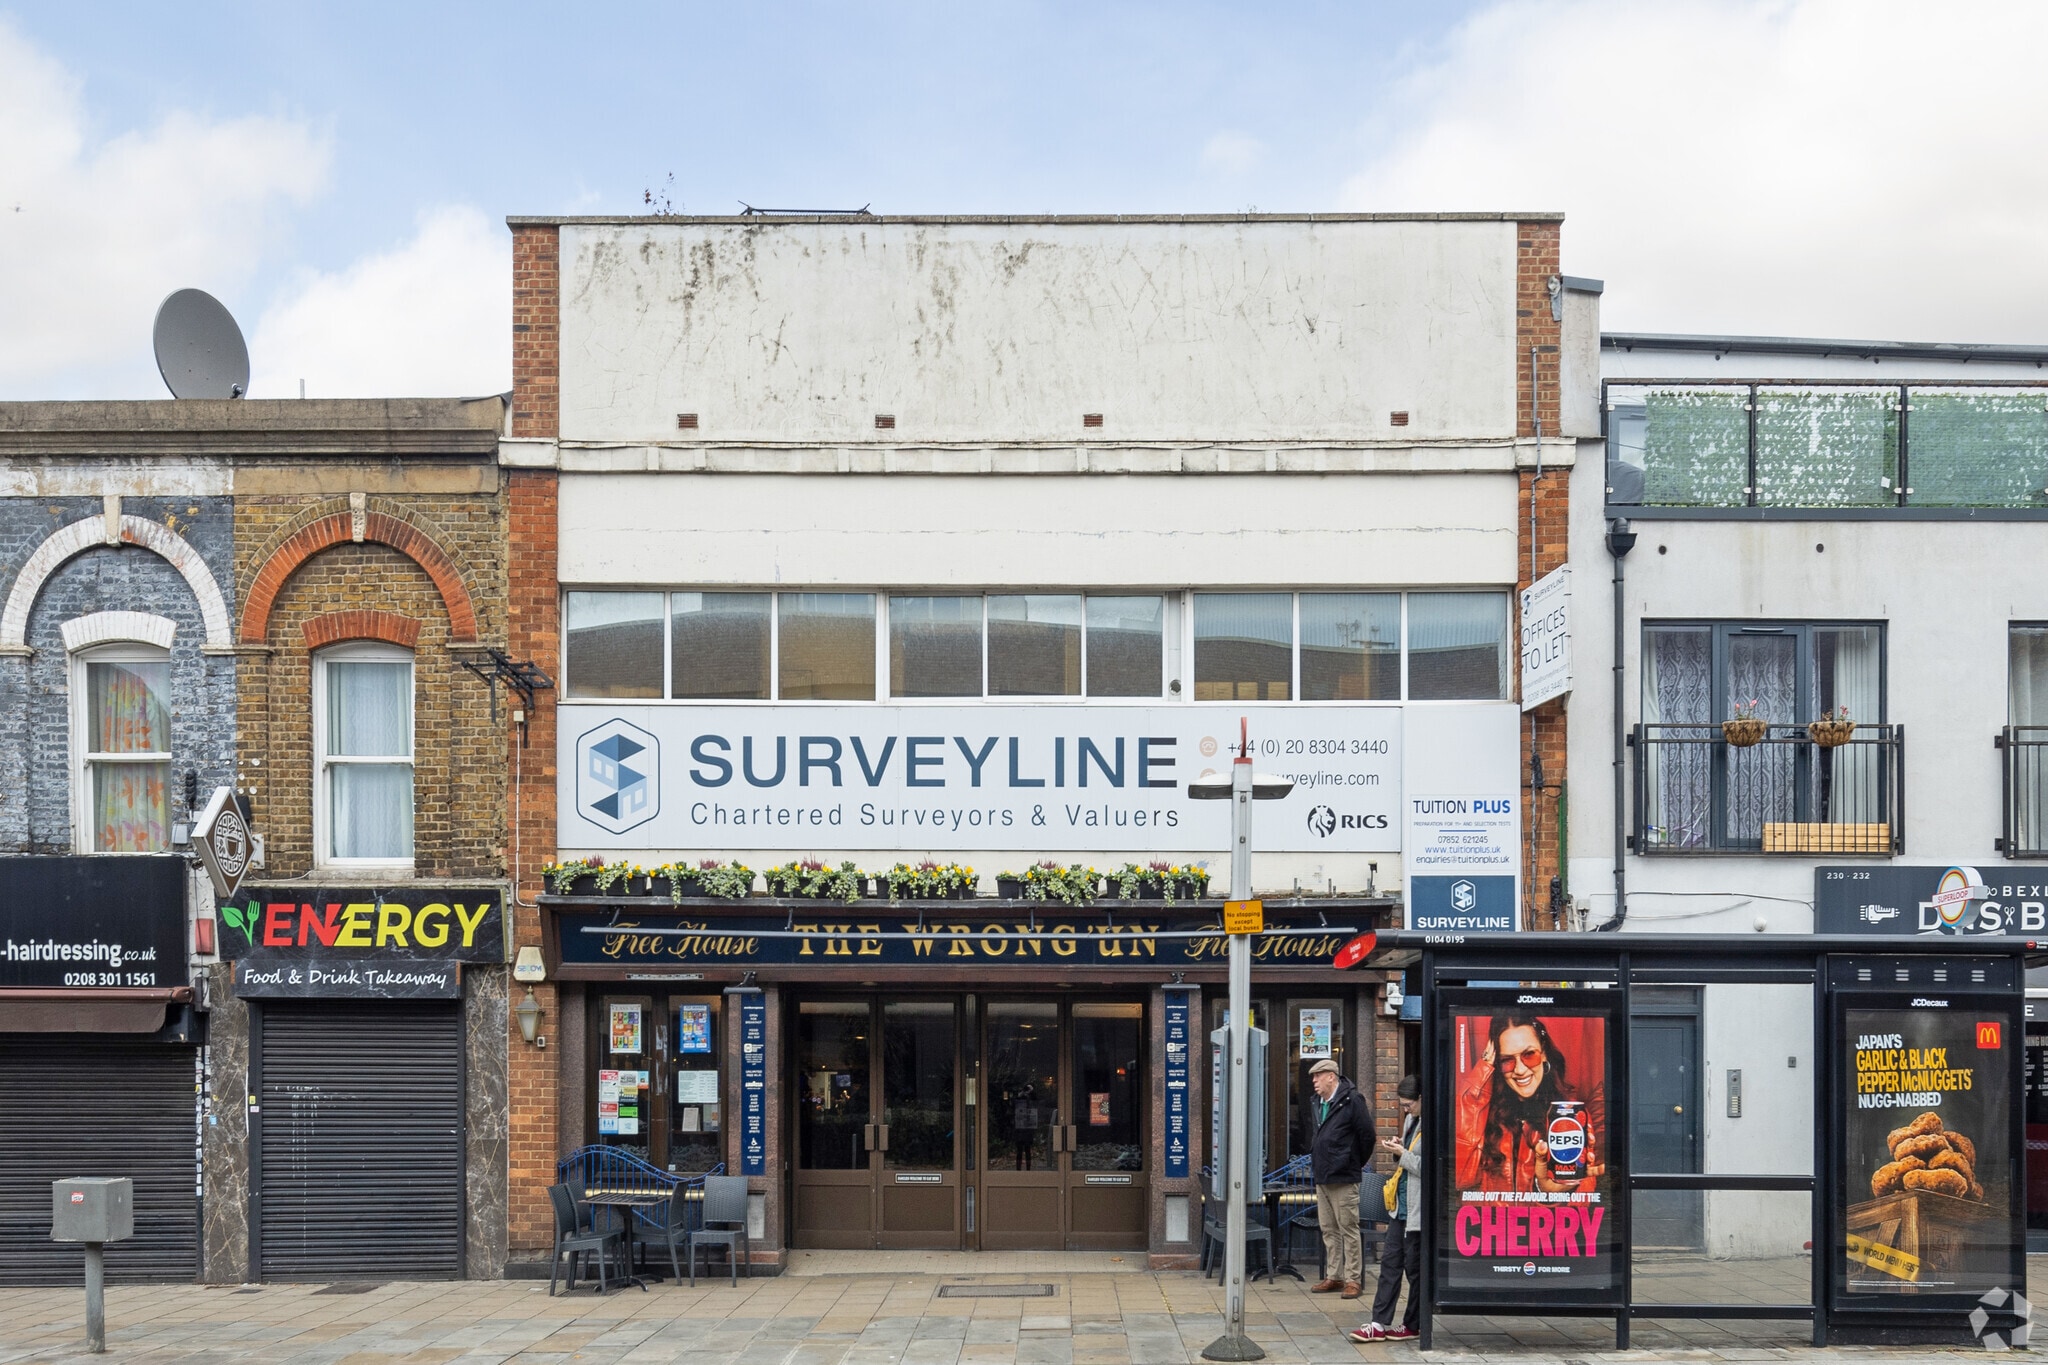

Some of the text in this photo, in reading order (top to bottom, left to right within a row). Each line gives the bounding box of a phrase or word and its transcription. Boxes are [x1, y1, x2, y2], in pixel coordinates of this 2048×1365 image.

[1522, 606, 1566, 647] OFFICES
[1522, 632, 1566, 674] TO LET
[1261, 739, 1281, 757] (0)
[1285, 739, 1304, 754] 20
[1309, 739, 1346, 754] 8304
[1351, 739, 1389, 754] 3440
[689, 734, 1178, 788] SURVEYLINE
[1413, 799, 1511, 814] TUITION PLUS
[691, 802, 1179, 832] Chartered Surveyors & Valuers
[1341, 814, 1389, 829] RICS
[1437, 835, 1489, 844] 07852 621245
[1425, 845, 1501, 854] www.tuitionplus.uk
[1416, 856, 1510, 864] enquiries@tuitionplus.uk
[1826, 872, 1844, 880] 230
[1852, 872, 1870, 880] 232
[1936, 889, 1969, 904] SUPERLOOP
[1234, 918, 1253, 926] except
[1236, 911, 1261, 919] stopping
[1417, 916, 1510, 928] SURVEYLINE
[263, 903, 491, 948] ENERGY
[602, 920, 759, 959] Free House
[793, 923, 884, 956] THE
[1250, 922, 1342, 960] House
[1425, 935, 1465, 944] 0104 0195
[64, 972, 156, 986] 0208 301 1561
[244, 969, 447, 989] Food & Drink Takeaway
[1517, 995, 1554, 1004] JCDecaux
[1911, 998, 1948, 1007] JCDecaux
[1856, 1034, 1903, 1050] JAPAN'S
[1856, 1048, 1948, 1072] GARLIC & BLACK
[1857, 1071, 1900, 1093] PEPPER
[1858, 1092, 1942, 1109] NUGG-NABBED
[1550, 1135, 1583, 1145] PEPSI
[1462, 1191, 1601, 1203] BRING OUT THE FLAVOUR. BRING OUT THE
[1455, 1205, 1605, 1257] CHERRY
[1863, 1246, 1885, 1261] WORLD
